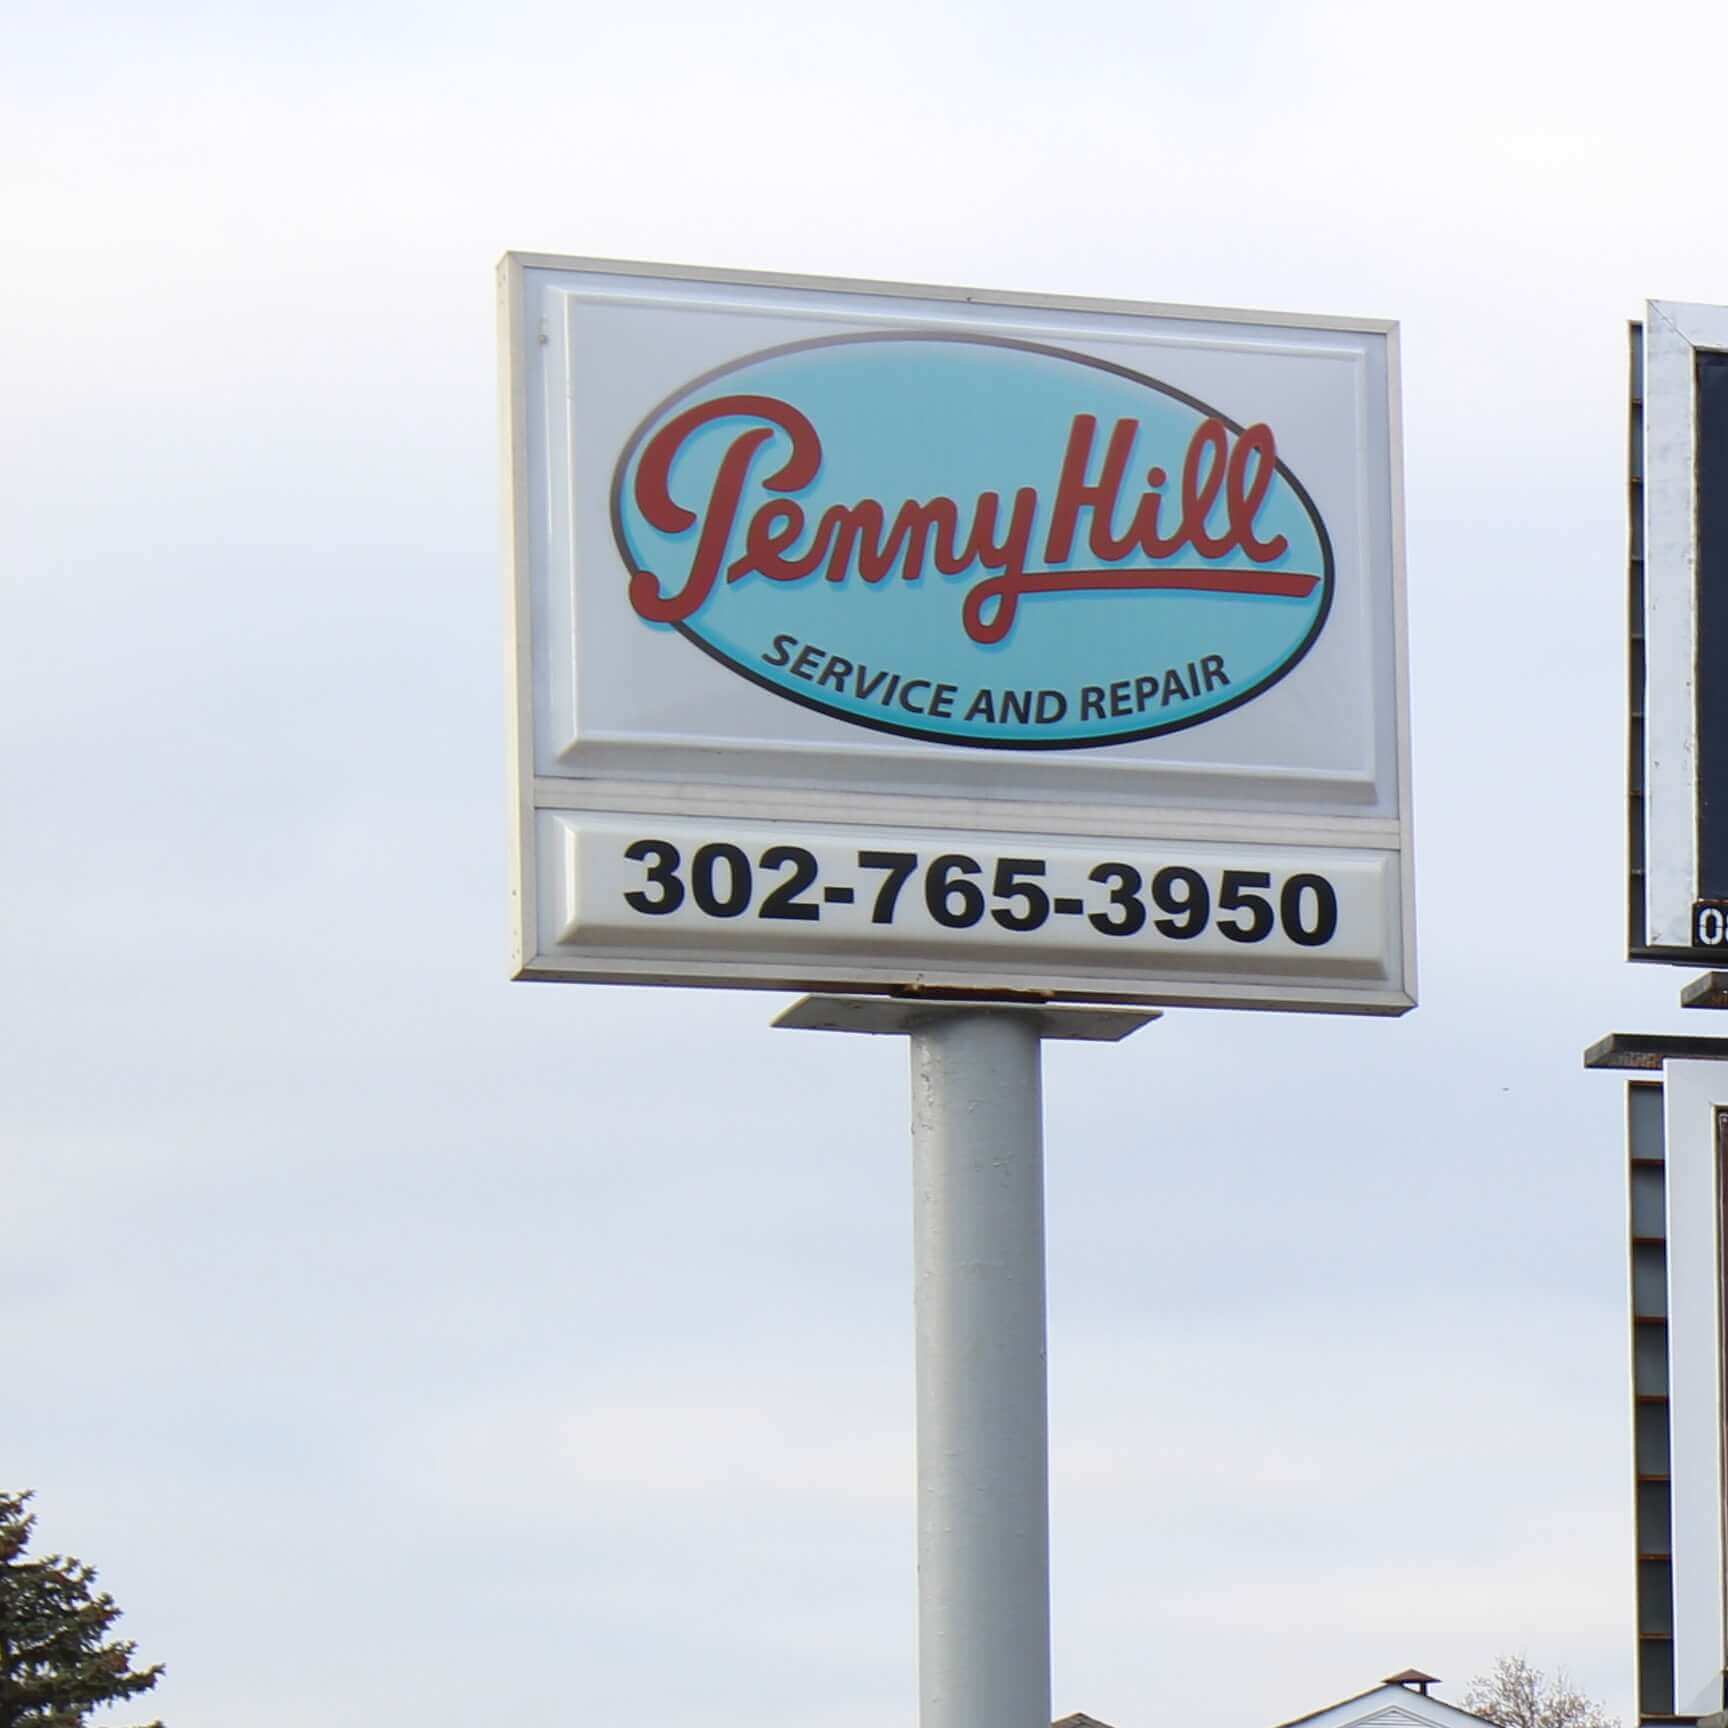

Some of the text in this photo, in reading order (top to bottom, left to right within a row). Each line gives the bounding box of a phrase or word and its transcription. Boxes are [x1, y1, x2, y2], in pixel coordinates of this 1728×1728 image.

[628, 394, 1290, 645] Penny Hill
[761, 634, 1230, 726] SERVICE AND REPAIR
[622, 838, 1339, 948] 302-765-3950
